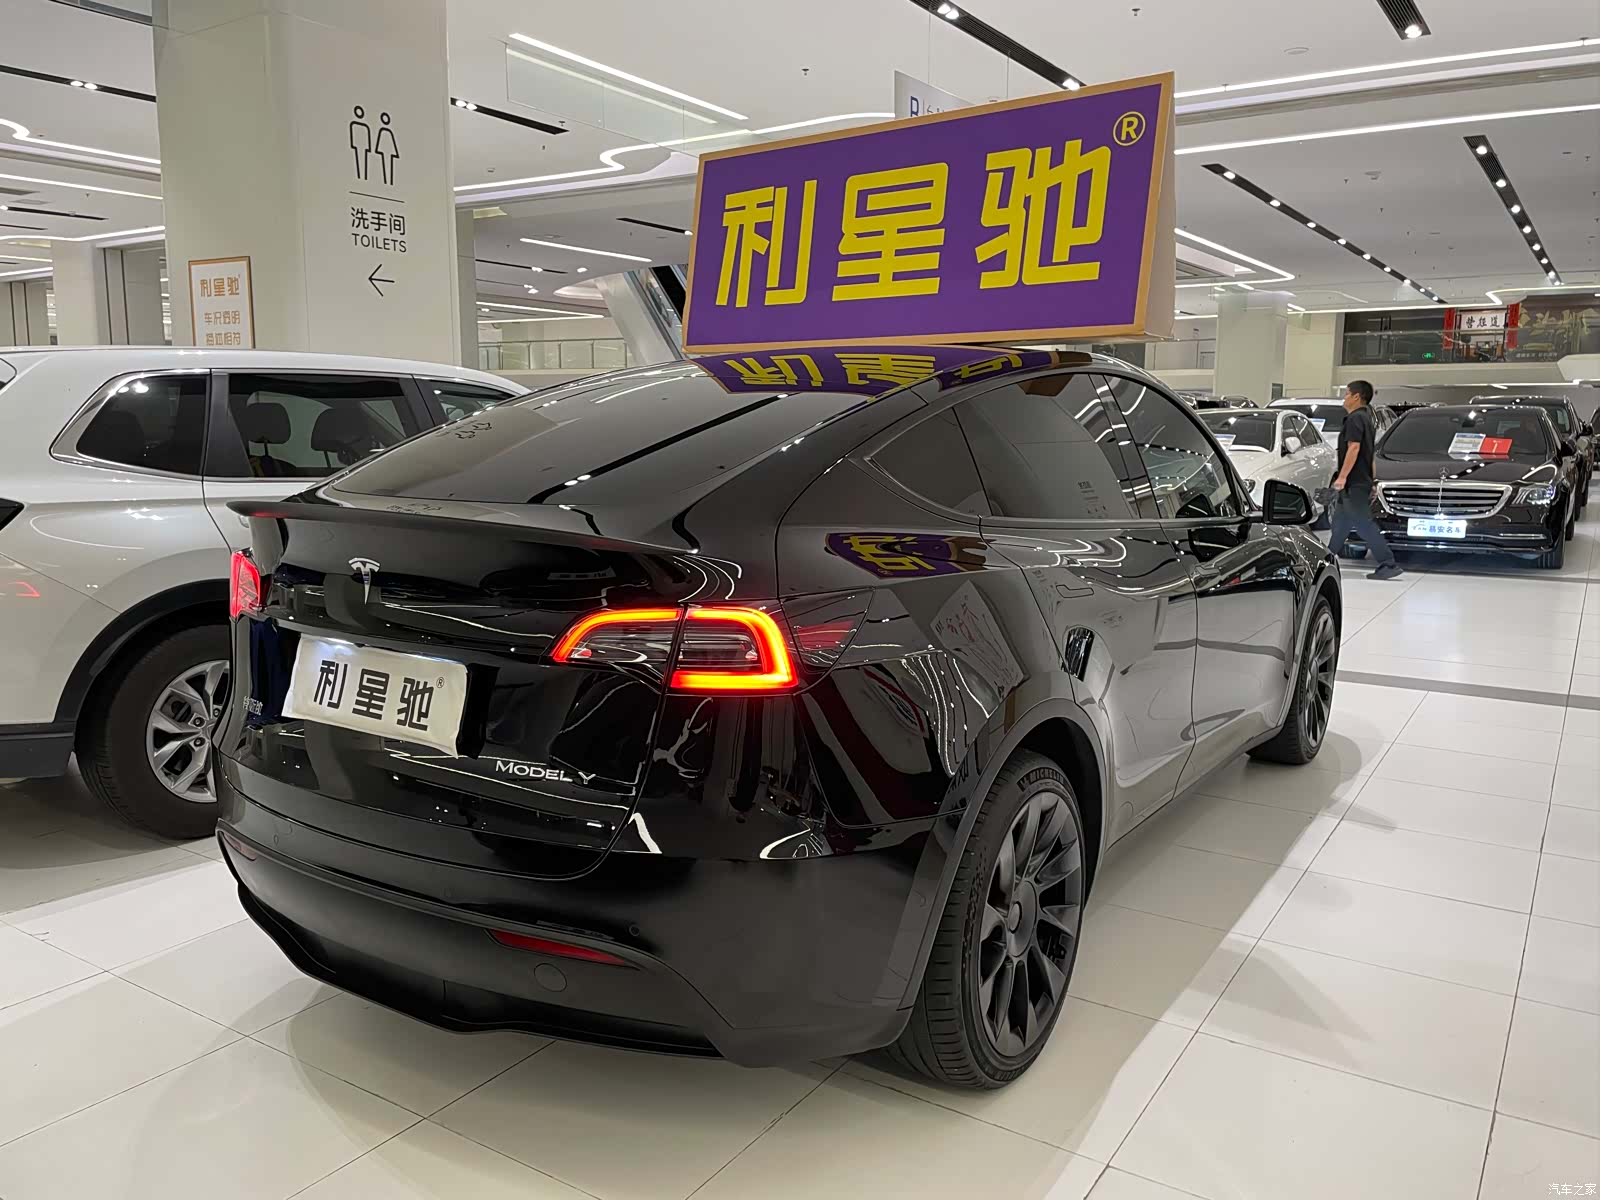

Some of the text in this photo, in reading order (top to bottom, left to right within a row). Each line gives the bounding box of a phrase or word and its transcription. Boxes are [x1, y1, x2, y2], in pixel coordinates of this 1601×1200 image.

[350, 207, 406, 235] 洗手间
[715, 140, 1112, 308] 利星驰
[351, 233, 407, 253] TOILETS
[199, 276, 240, 298] 利星驰
[204, 310, 240, 325] 车况透明
[313, 660, 434, 732] 利星驰
[494, 760, 597, 786] MODEL Y
[1029, 767, 1064, 784] MICHELIN
